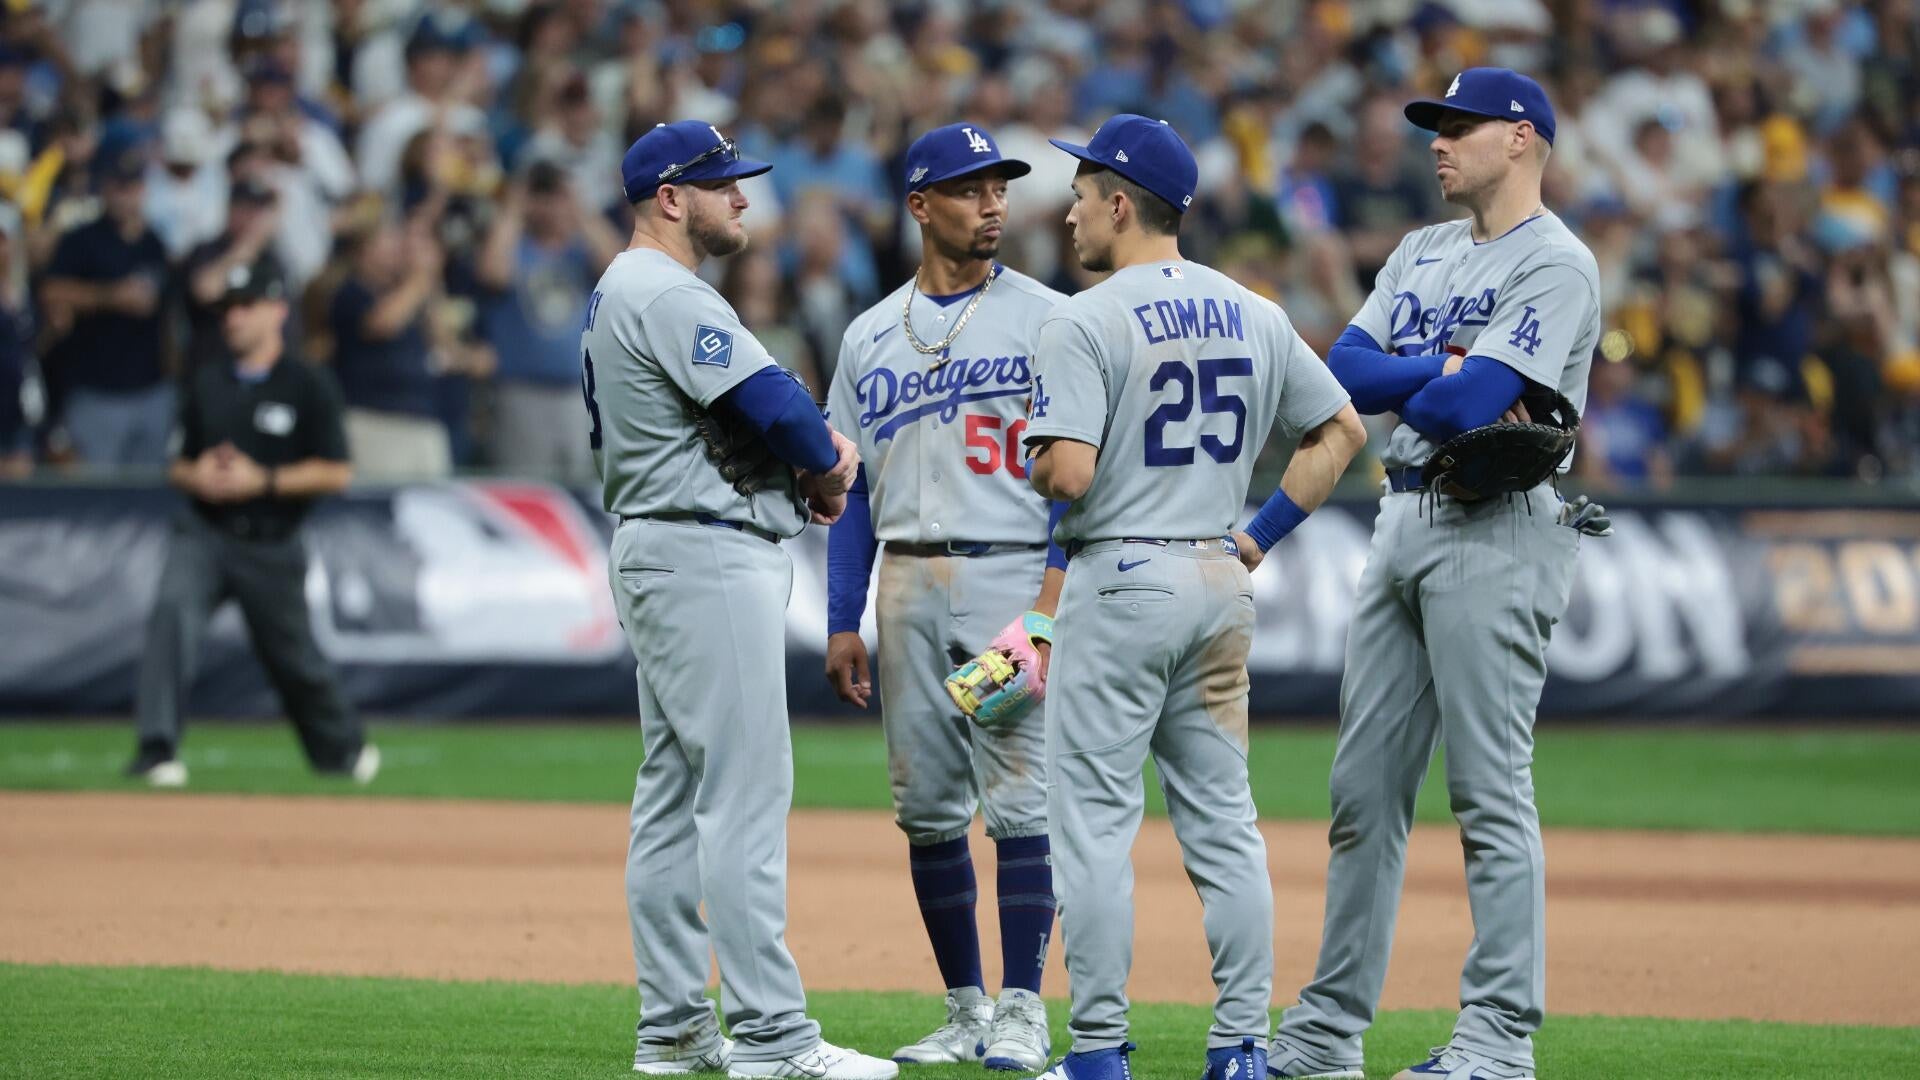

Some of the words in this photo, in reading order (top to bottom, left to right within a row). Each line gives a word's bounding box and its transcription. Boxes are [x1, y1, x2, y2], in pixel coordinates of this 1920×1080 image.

[962, 128, 991, 152] LA
[1133, 298, 1244, 344] EDMAN
[1508, 306, 1542, 357] LA
[857, 347, 1031, 429] Dodgers
[1145, 357, 1253, 467] 25
[1762, 540, 1920, 635] 20
